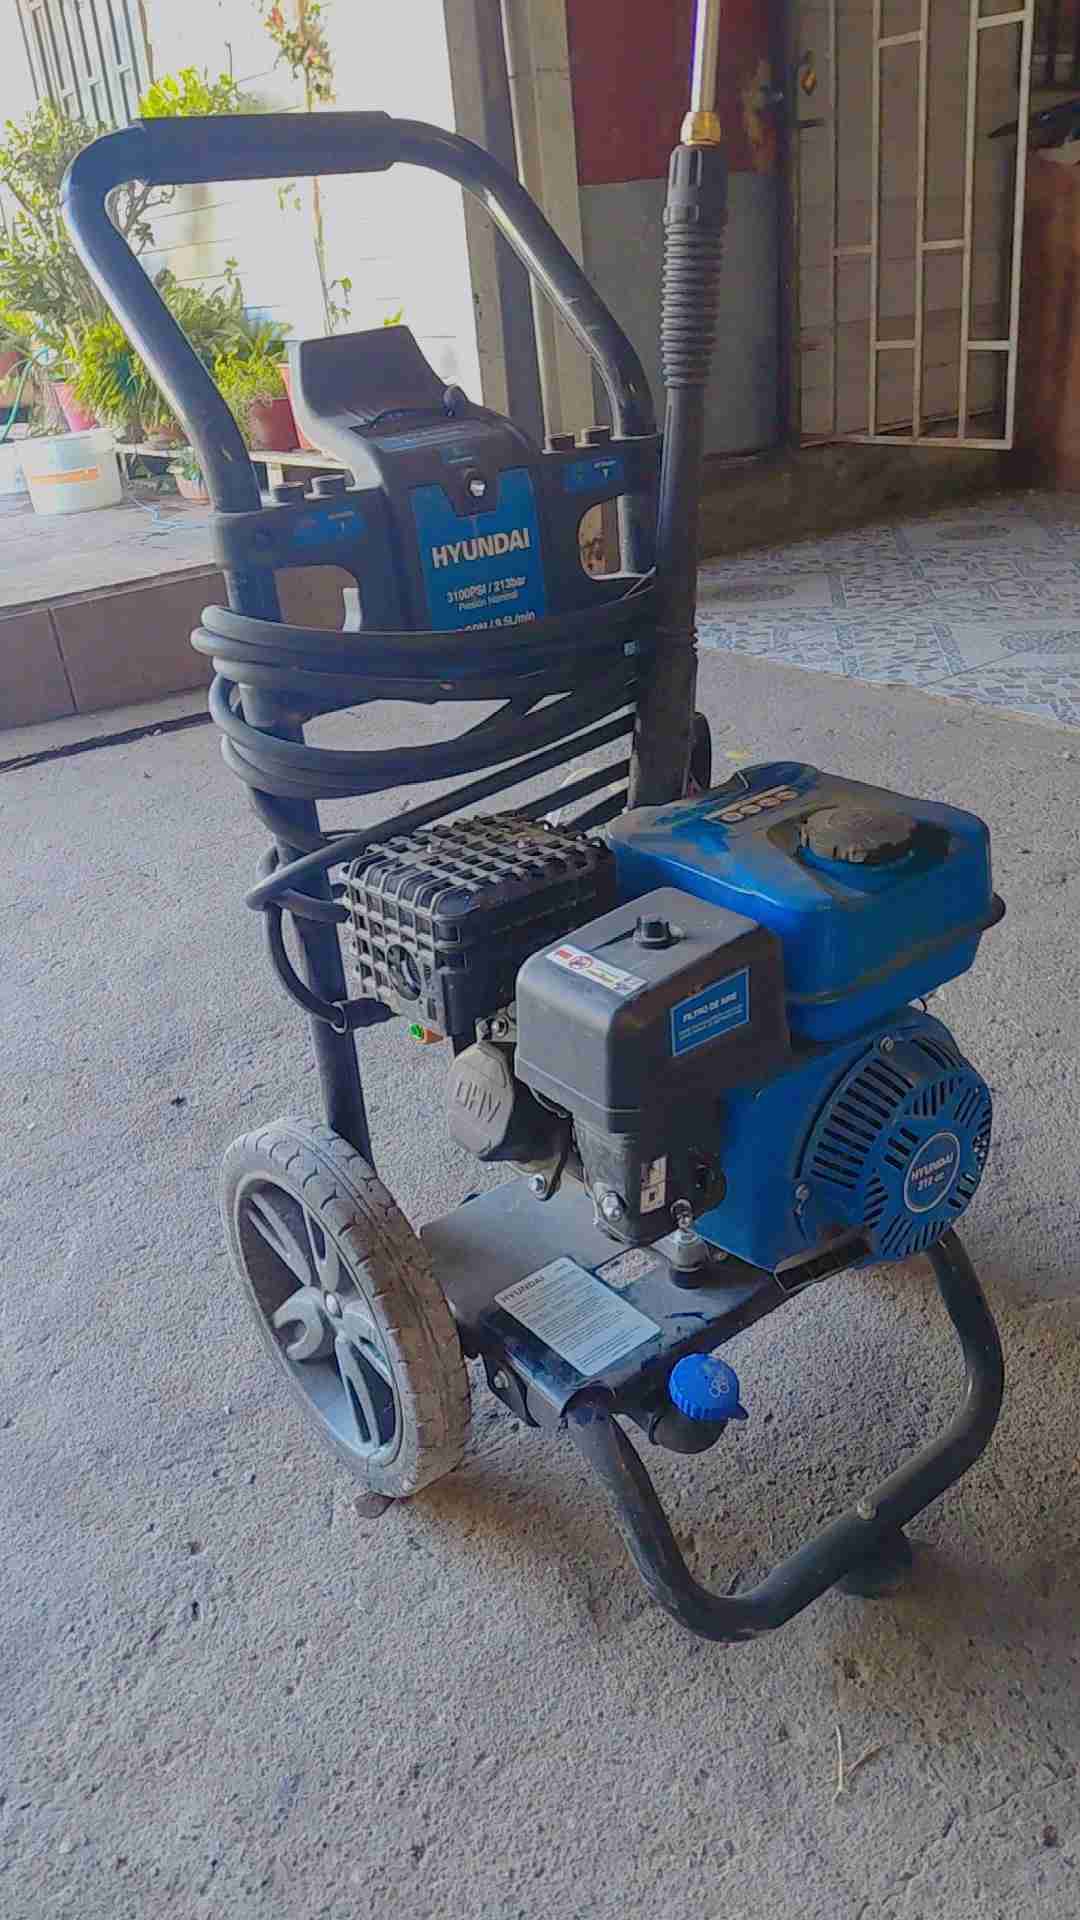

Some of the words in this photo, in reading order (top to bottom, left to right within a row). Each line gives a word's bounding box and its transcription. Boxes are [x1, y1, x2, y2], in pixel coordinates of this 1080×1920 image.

[431, 527, 530, 569] HYUNDAI
[446, 583, 486, 603] 3100PSI
[493, 576, 526, 592] 213bar
[707, 999, 719, 1011] DE
